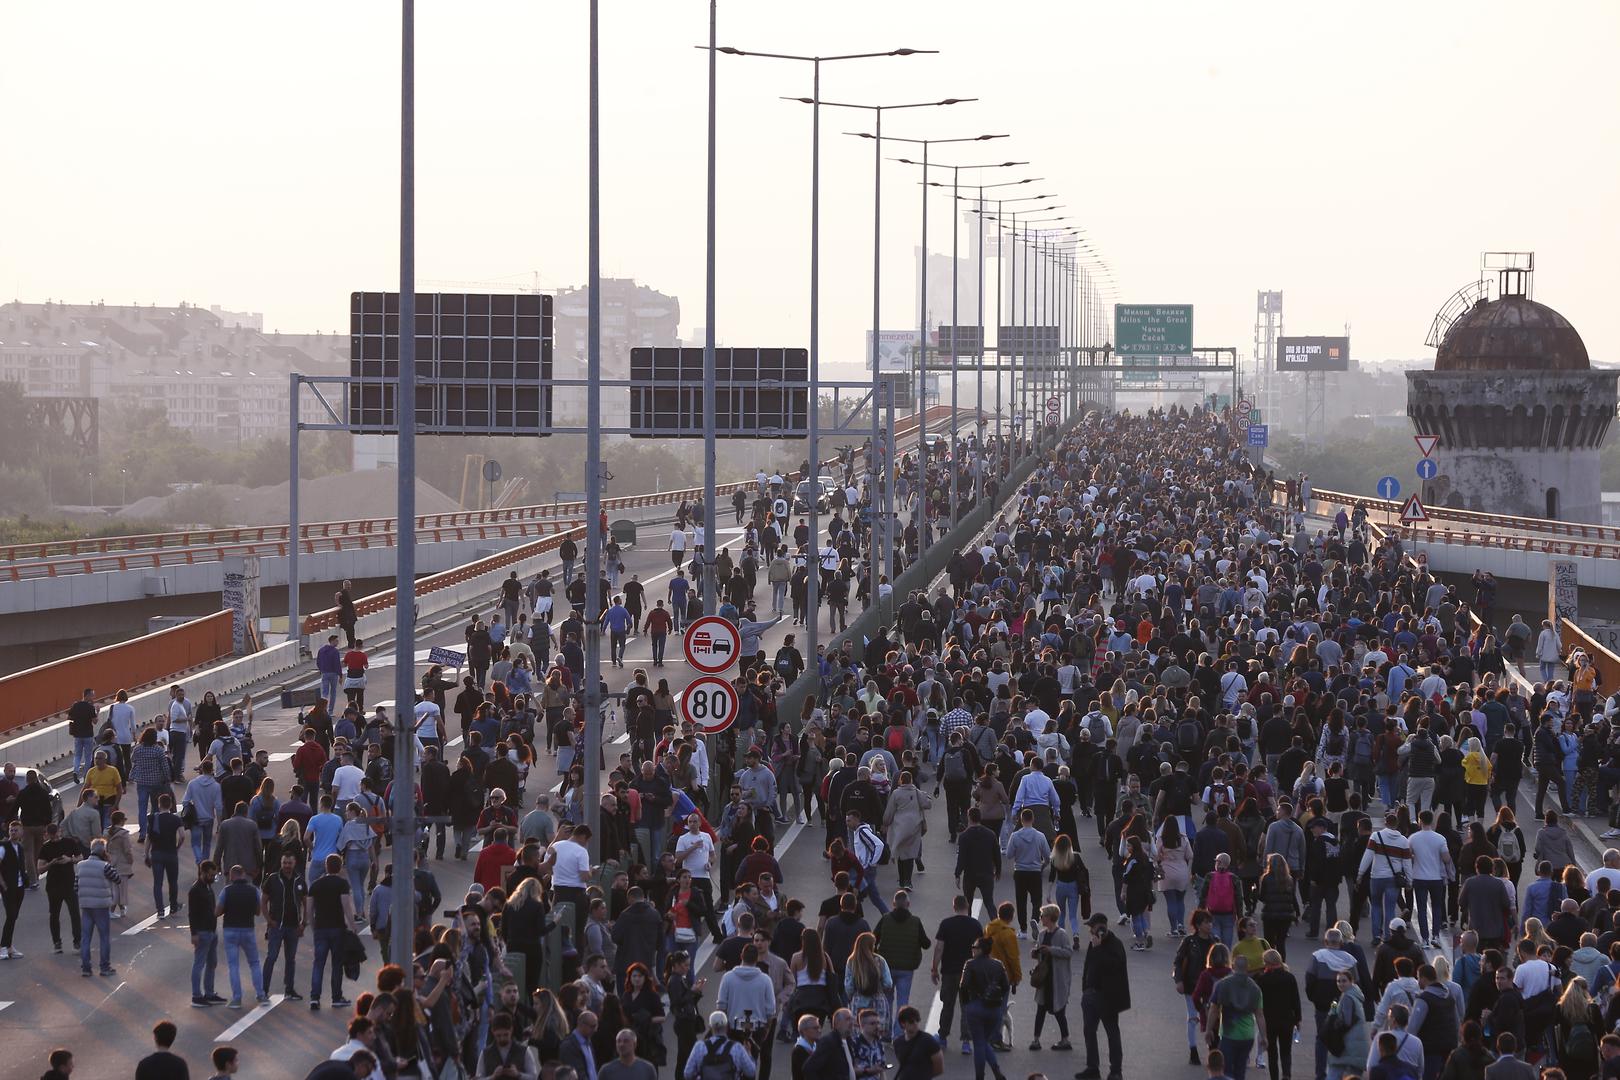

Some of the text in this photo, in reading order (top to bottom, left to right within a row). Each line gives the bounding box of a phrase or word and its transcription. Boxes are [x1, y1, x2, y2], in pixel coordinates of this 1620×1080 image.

[1124, 308, 1185, 316] Милош Велики
[1147, 316, 1160, 324] the
[1166, 316, 1188, 324] Great
[1141, 325, 1166, 333] Чачак
[1239, 419, 1249, 429] 80
[692, 689, 727, 720] 80
